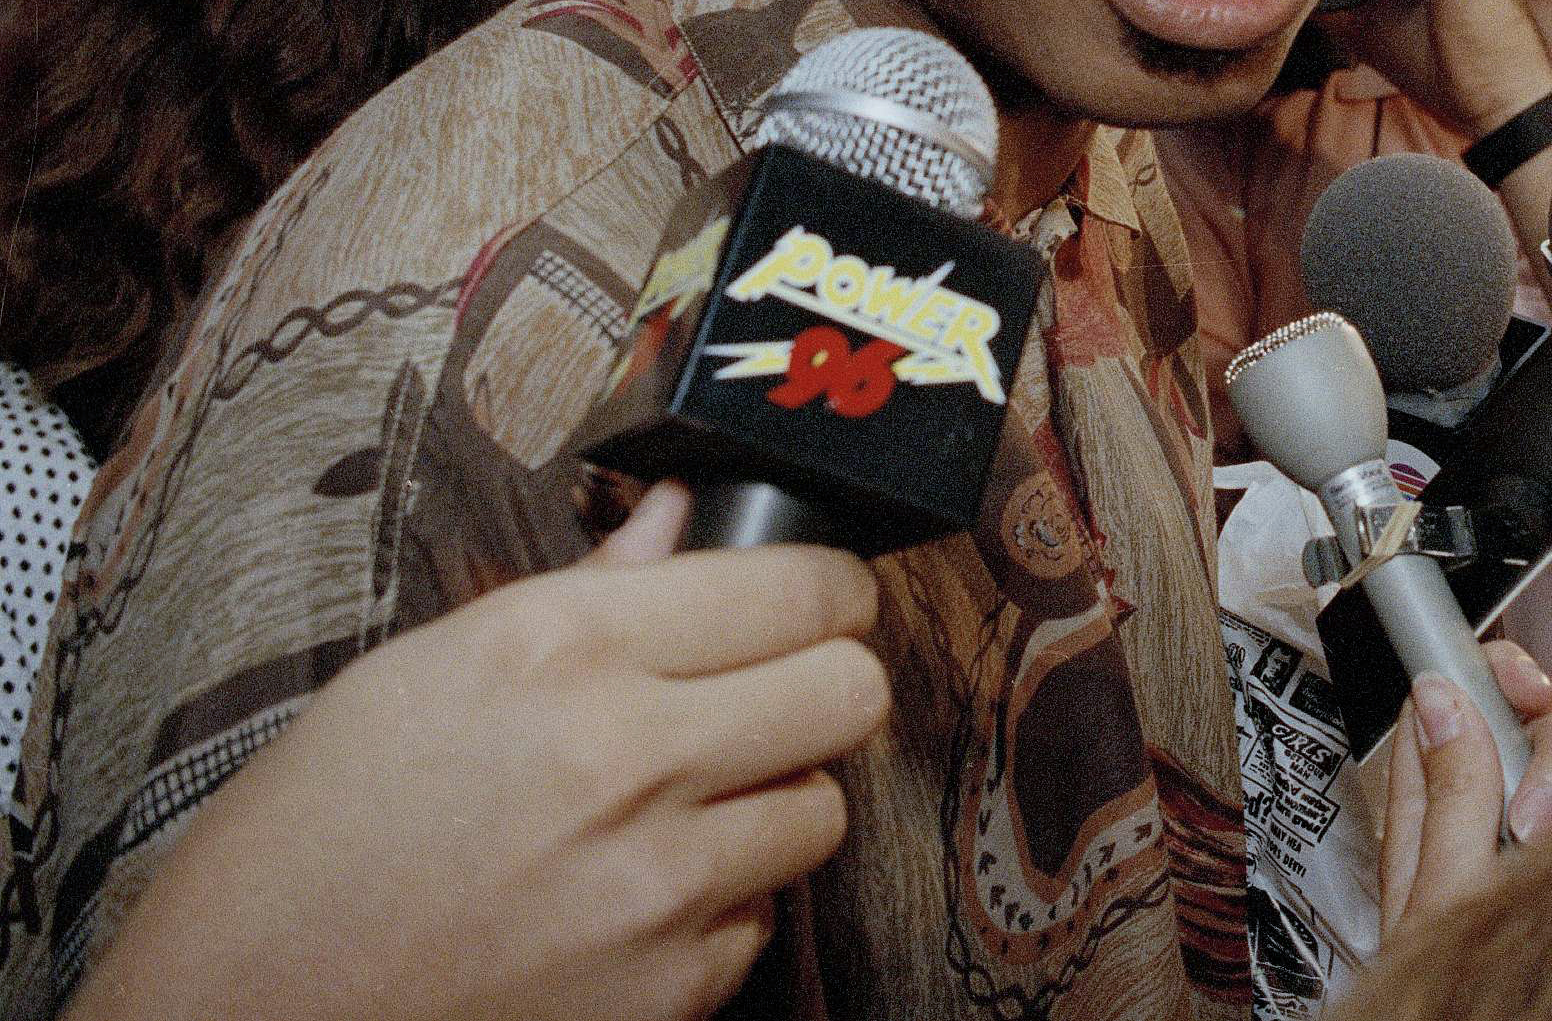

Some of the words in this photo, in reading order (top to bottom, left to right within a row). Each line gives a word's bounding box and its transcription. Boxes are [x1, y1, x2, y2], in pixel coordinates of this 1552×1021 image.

[726, 223, 1006, 402] POWER
[767, 325, 912, 418] 96
[1271, 723, 1332, 763] GIRLS
[1289, 761, 1312, 781] MAN
[1302, 758, 1326, 781] YOUR
